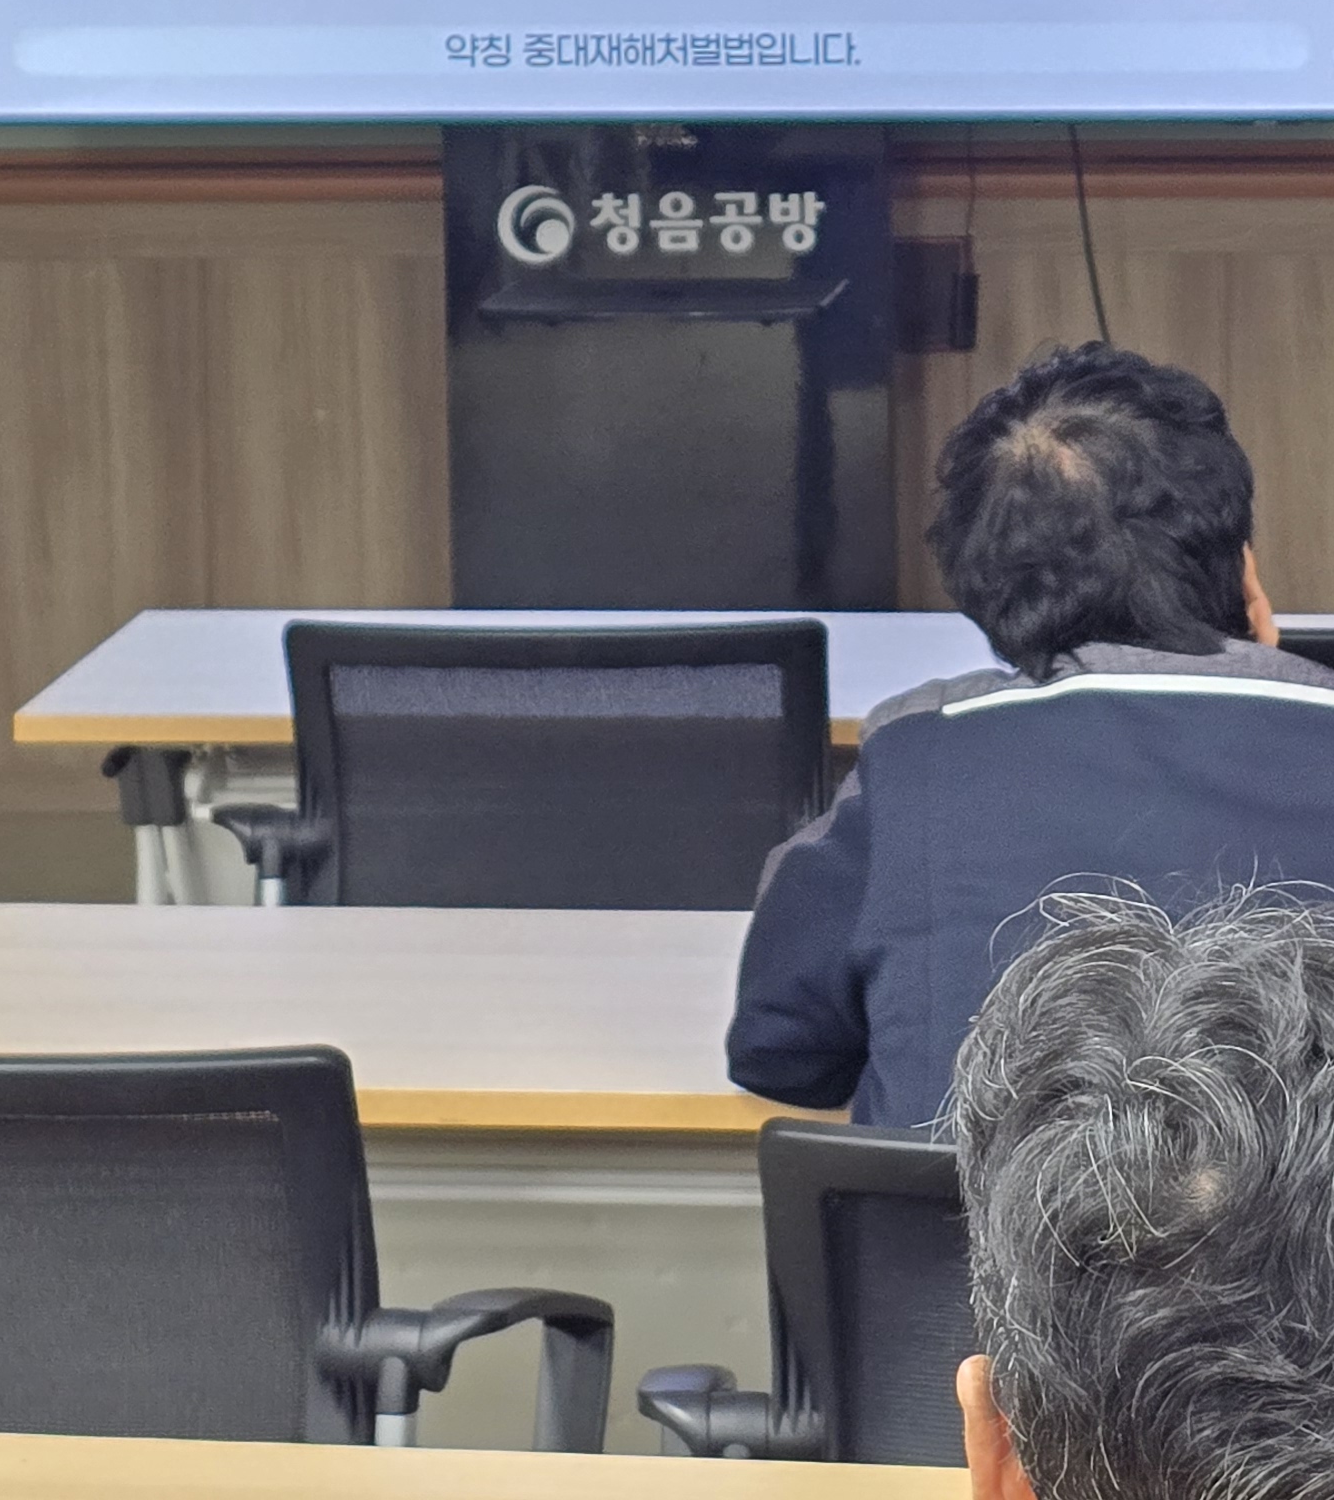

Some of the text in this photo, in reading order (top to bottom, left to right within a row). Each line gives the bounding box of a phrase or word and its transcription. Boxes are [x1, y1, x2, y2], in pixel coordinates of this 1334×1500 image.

[445, 33, 862, 68] 약칭 중대재해처벌법입니다.
[590, 191, 825, 254] 청음공방
